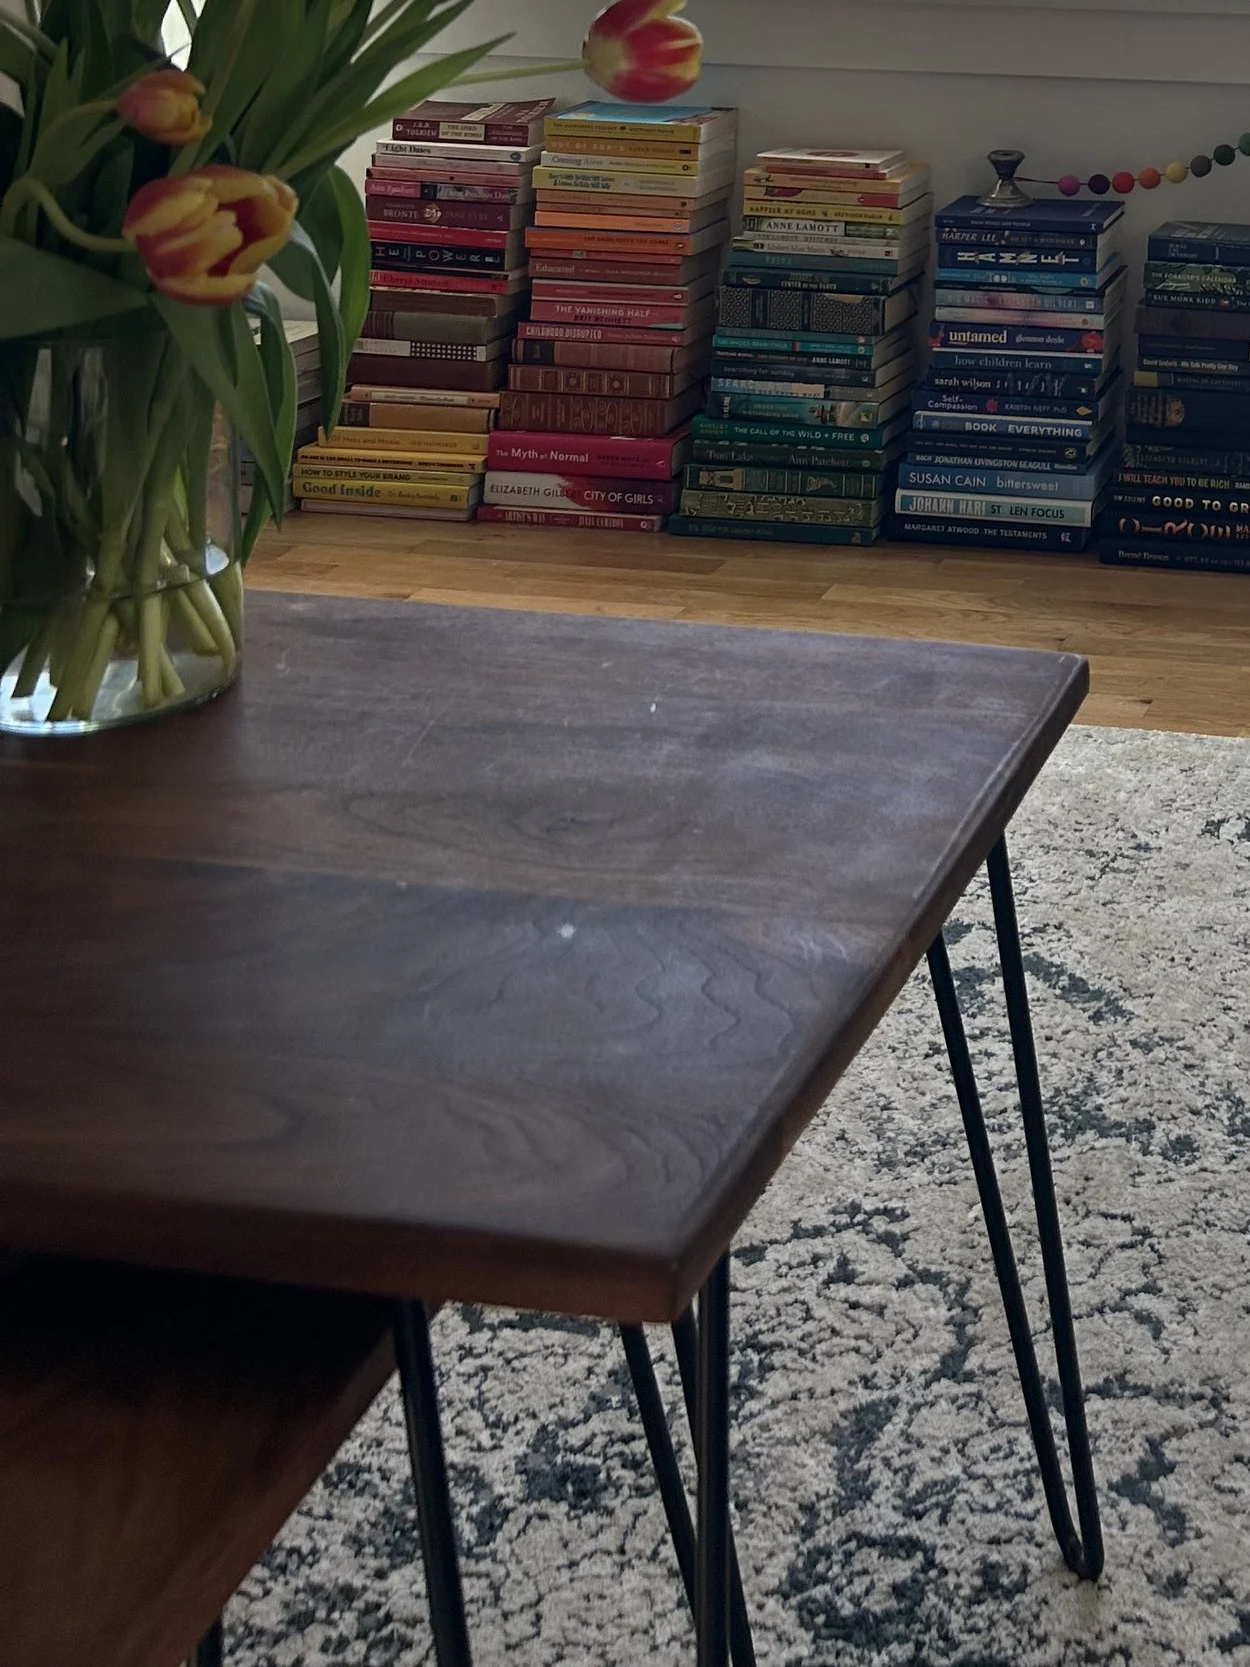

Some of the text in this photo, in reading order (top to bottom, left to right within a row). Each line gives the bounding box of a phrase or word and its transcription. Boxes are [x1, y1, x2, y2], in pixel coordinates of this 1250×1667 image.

[406, 128, 437, 137] TOLKIEN
[552, 155, 582, 166] Coming
[749, 205, 781, 215] HAPPIER
[783, 207, 794, 215] AT
[766, 221, 839, 233] ANNE LAMOTT
[942, 231, 996, 243] HARPER LEE
[956, 251, 1080, 266] HAMNET
[535, 262, 575, 274] Educated
[1171, 295, 1194, 303] MONK
[1196, 296, 1217, 304] KIDD
[556, 305, 650, 318] THE VANISHING HALF
[526, 325, 602, 339] CHILDHOOD DISRUPTED
[948, 330, 1007, 344] untamed
[1015, 335, 1065, 346] glennon doyle
[954, 356, 1052, 370] how children learn
[934, 377, 960, 387] sarah
[962, 378, 991, 389] wilson
[927, 400, 978, 412] Compassion
[734, 426, 748, 434] THE
[749, 427, 768, 435] CALL
[769, 428, 780, 436] OF
[782, 429, 796, 437] THE
[798, 430, 822, 439] WILD
[831, 432, 855, 441] FREE
[965, 421, 1083, 438] BOOK EVERYTHING
[496, 449, 508, 457] The
[510, 448, 538, 461] Myth
[550, 450, 589, 463] Normal
[707, 449, 754, 462] Tom Lake
[788, 454, 809, 466] Ann
[934, 455, 972, 466] JONATHAN
[974, 457, 1018, 469] LIVINGSTON
[1018, 459, 1051, 471] SEAGULL
[301, 468, 411, 481] HOW TO STYLE YOUR BRAND
[908, 472, 987, 487] SUSAN CAIN
[996, 476, 1059, 491] bittersweet
[1123, 473, 1142, 483] WILL
[1143, 475, 1168, 485] TEACH
[1169, 476, 1185, 486] YOU
[1186, 477, 1197, 487] TO
[1198, 478, 1208, 487] BE
[1210, 479, 1230, 490] RICH
[303, 481, 382, 498] Good Inside
[490, 484, 540, 495] ELIZABETH
[583, 490, 654, 505] CITY OF GIRLS
[1151, 495, 1195, 510] GOOD
[1202, 499, 1222, 512] TO
[908, 496, 986, 515] JOHANN HARI
[1031, 507, 1065, 519] FOCUS
[904, 522, 980, 535] MARGARET ATWOOD
[984, 527, 1048, 540] THE TESTAMENTS
[1143, 551, 1170, 562] Brown
